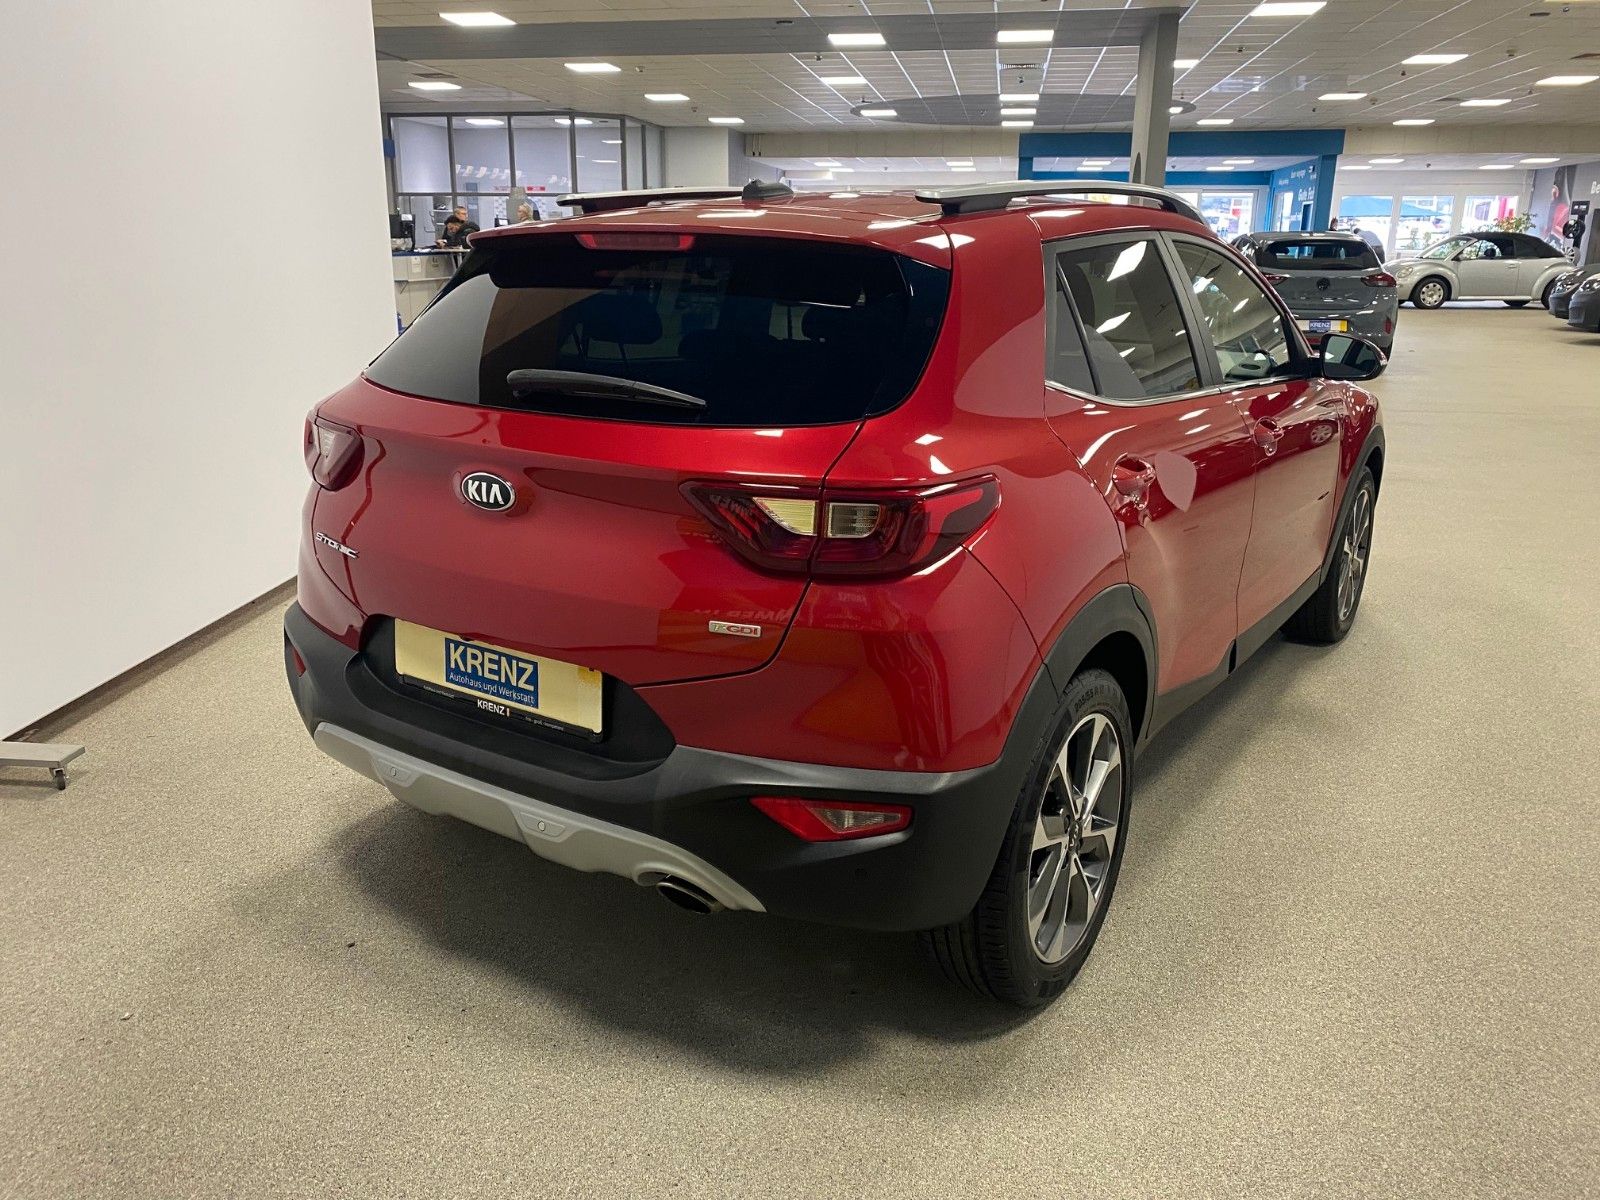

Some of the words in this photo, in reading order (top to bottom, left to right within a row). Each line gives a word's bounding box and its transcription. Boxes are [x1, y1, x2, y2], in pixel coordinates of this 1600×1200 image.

[467, 479, 505, 505] KIA
[449, 642, 535, 691] KRENZ
[449, 672, 482, 688] Autohaus
[483, 683, 498, 693] und
[498, 685, 536, 704] Werkstatt
[477, 699, 506, 716] KRENZ
